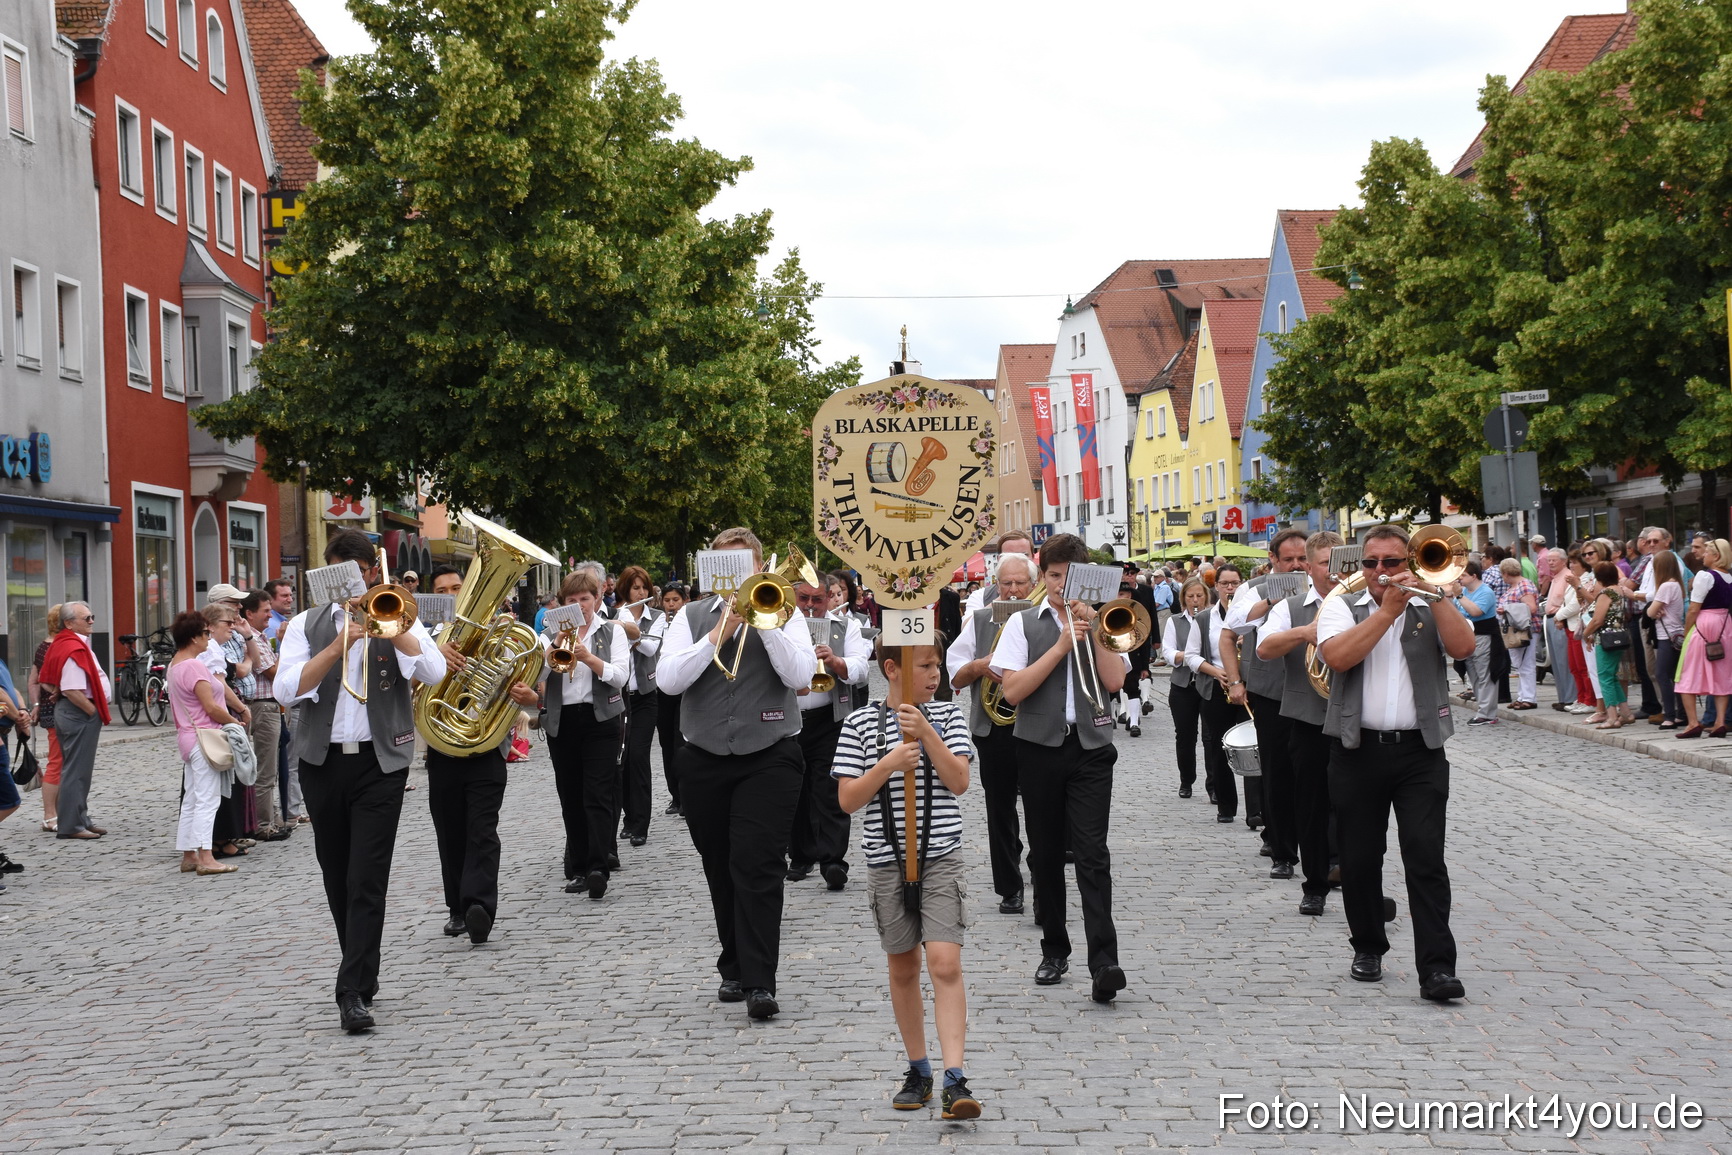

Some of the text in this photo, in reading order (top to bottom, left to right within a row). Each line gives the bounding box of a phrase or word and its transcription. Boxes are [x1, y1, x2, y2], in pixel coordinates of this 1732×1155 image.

[1074, 377, 1087, 407] K&L
[1510, 394, 1526, 402] Ulmer
[835, 415, 979, 435] BLASKAPELLE
[1153, 454, 1168, 470] HOTEL
[832, 464, 982, 562] THANNHAUSEN
[901, 617, 925, 634] 35
